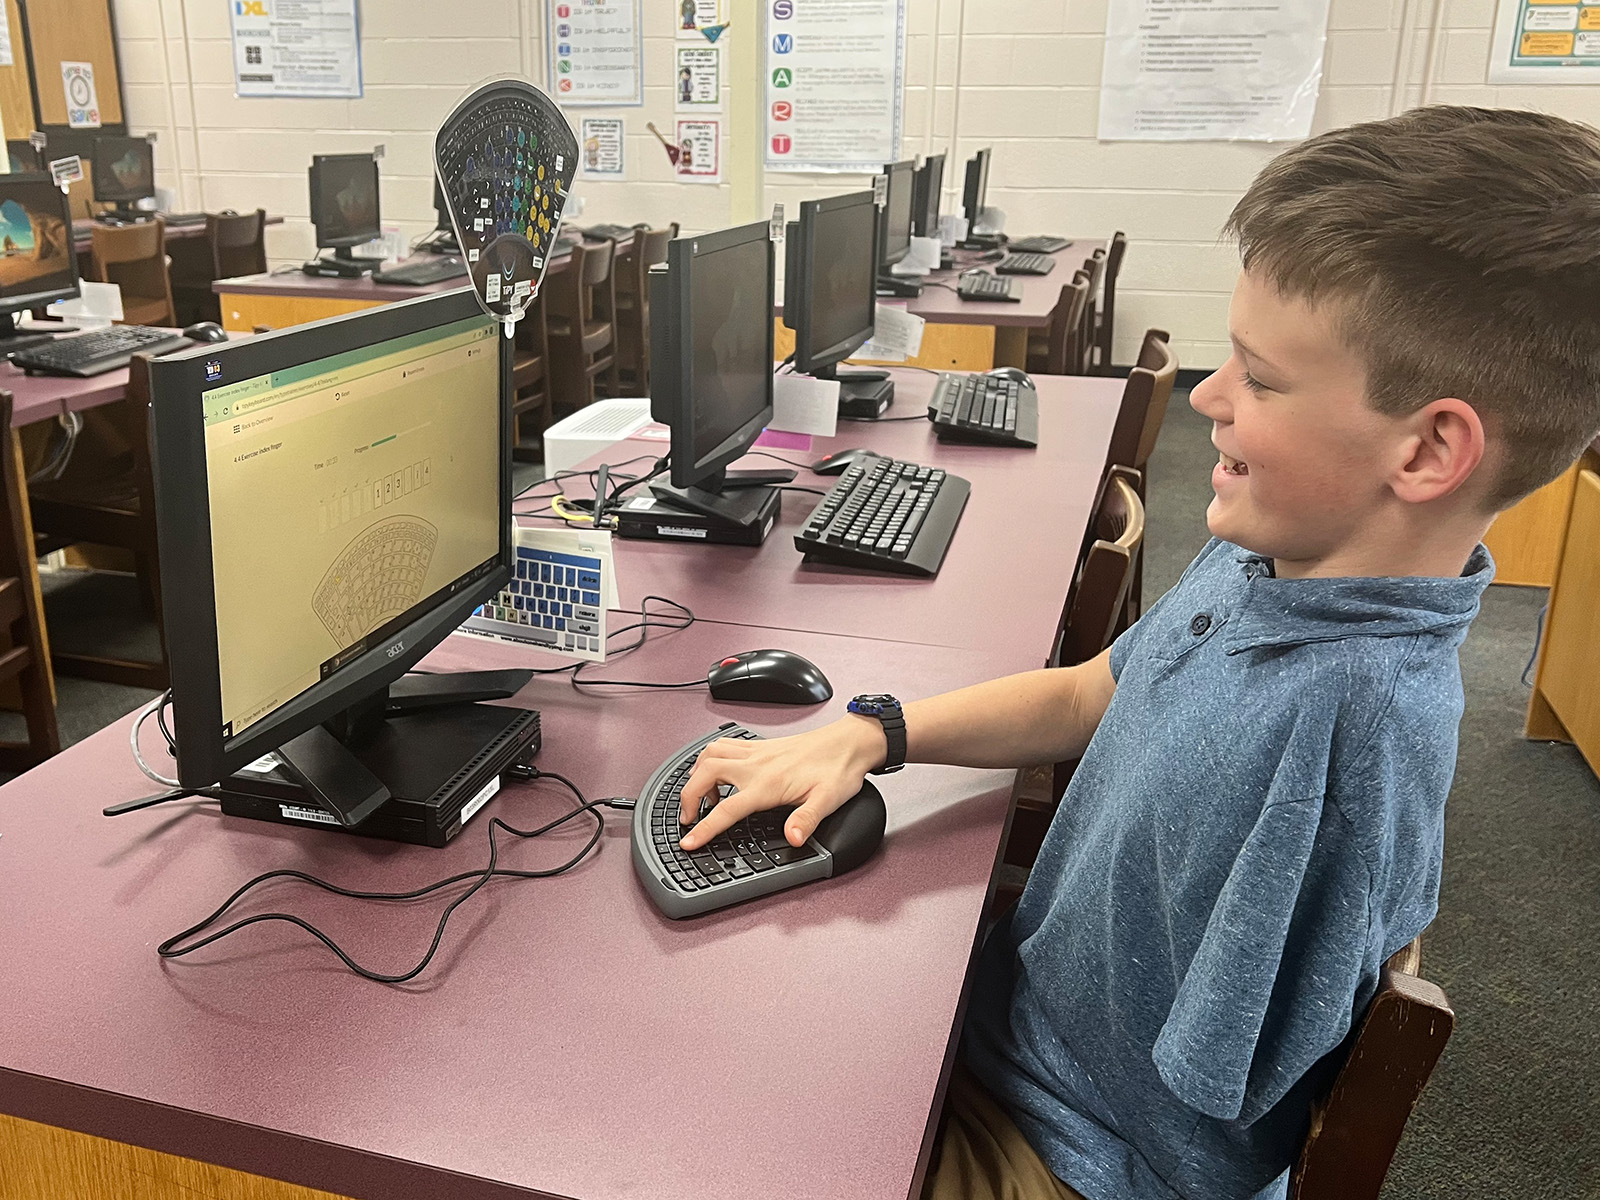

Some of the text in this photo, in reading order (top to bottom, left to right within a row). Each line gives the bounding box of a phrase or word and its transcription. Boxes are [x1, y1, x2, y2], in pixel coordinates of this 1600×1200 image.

[236, 1, 268, 16] IXL
[774, 0, 792, 20] S
[774, 35, 791, 53] M
[774, 69, 791, 87] A
[773, 102, 791, 120] R
[772, 135, 791, 153] T
[376, 489, 380, 498] 1
[387, 483, 391, 492] 2
[396, 479, 400, 488] 3
[503, 595, 511, 603] H
[386, 641, 404, 658] acer
